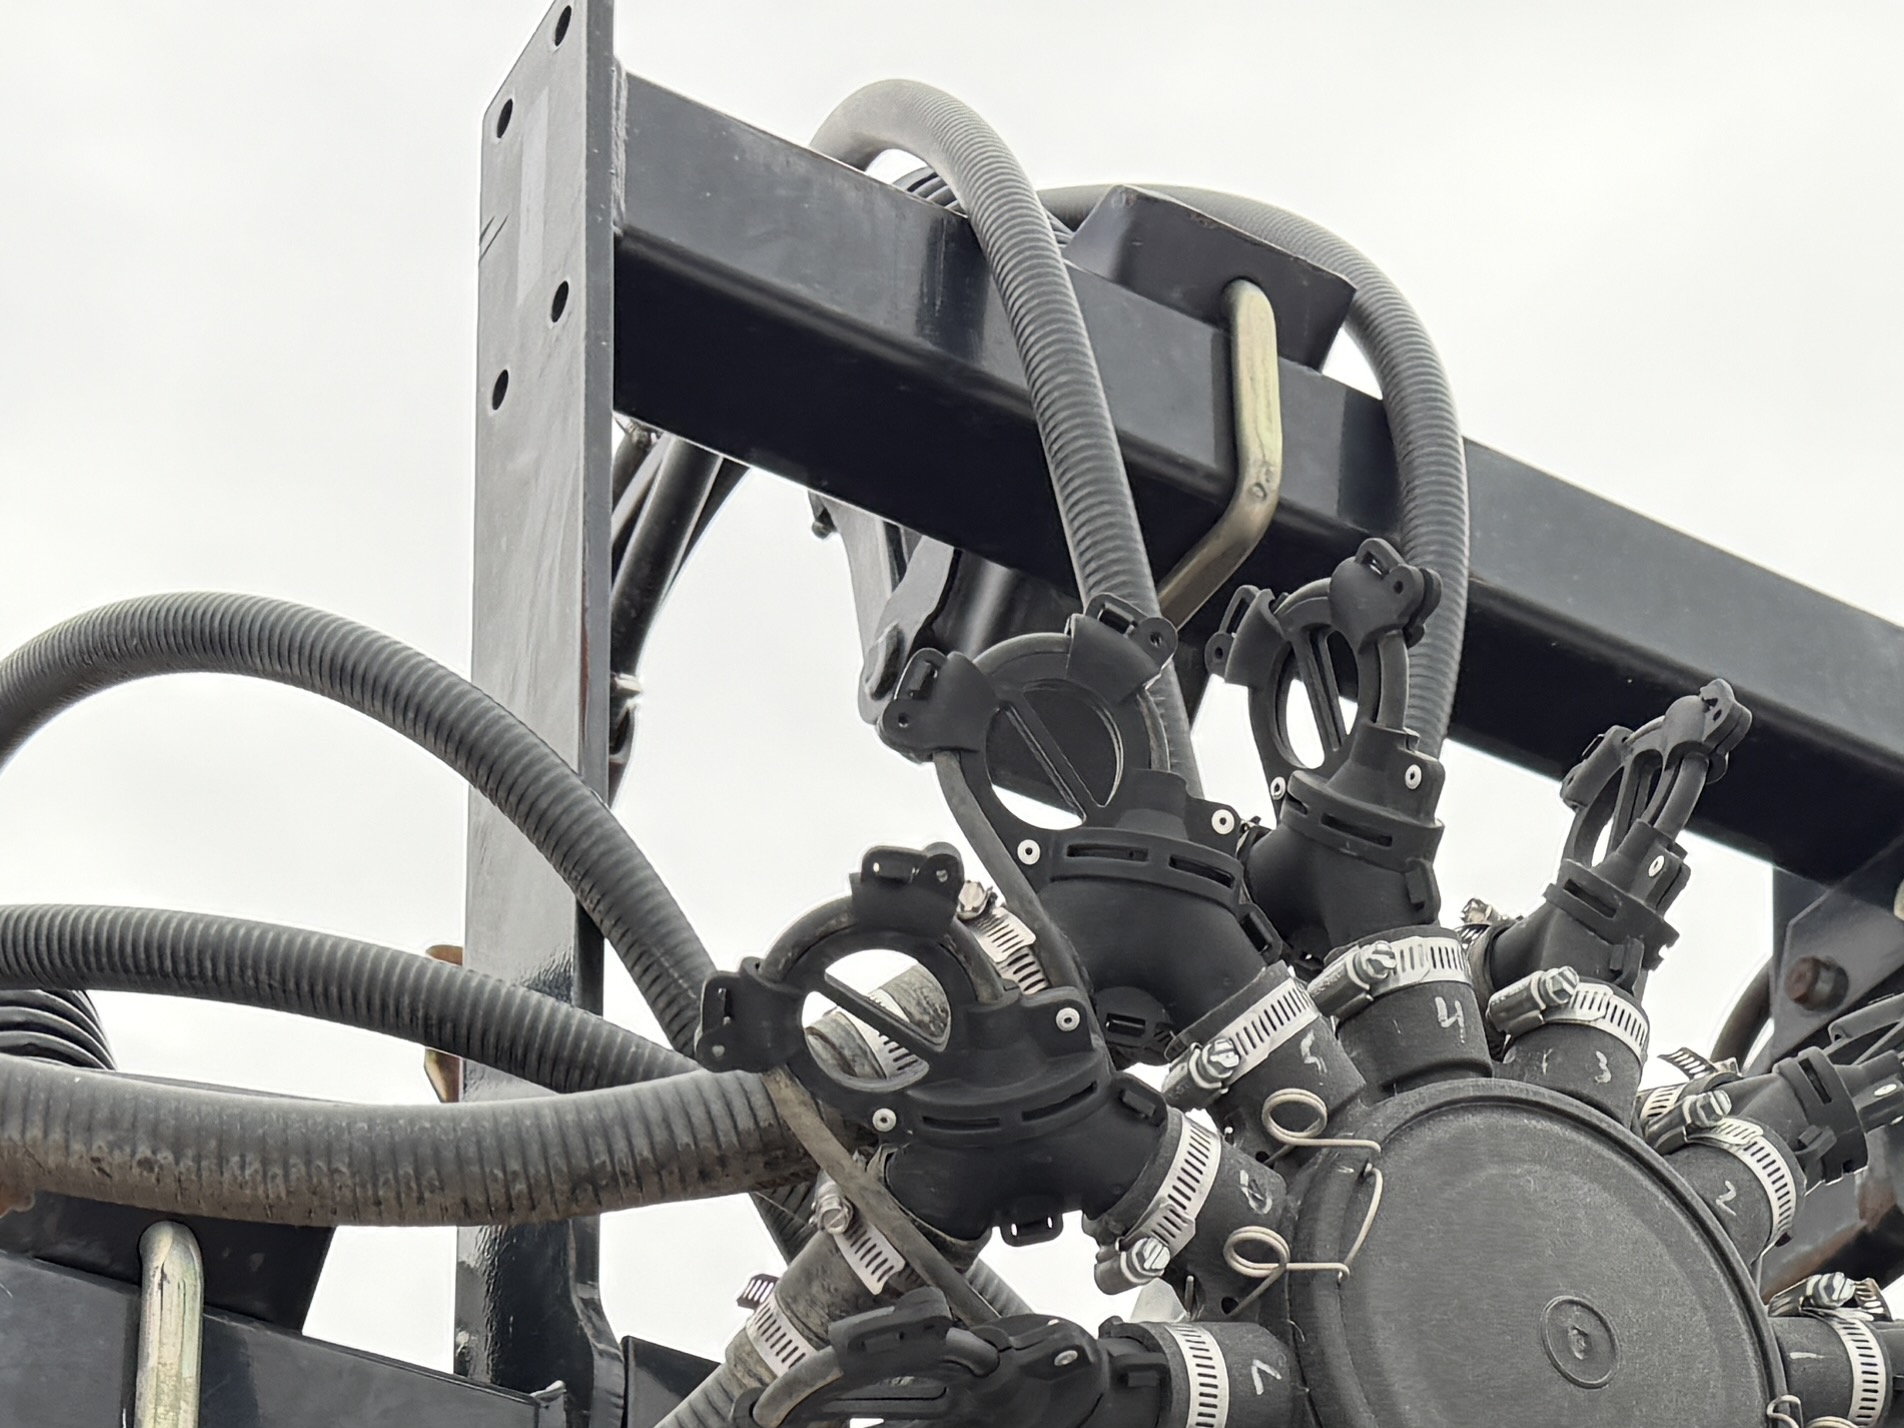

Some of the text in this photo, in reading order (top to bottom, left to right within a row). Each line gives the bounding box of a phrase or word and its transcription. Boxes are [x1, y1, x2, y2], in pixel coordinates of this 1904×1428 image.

[1434, 996, 1466, 1044] 4
[1594, 1050, 1613, 1084] 3
[1716, 1179, 1737, 1217] 2
